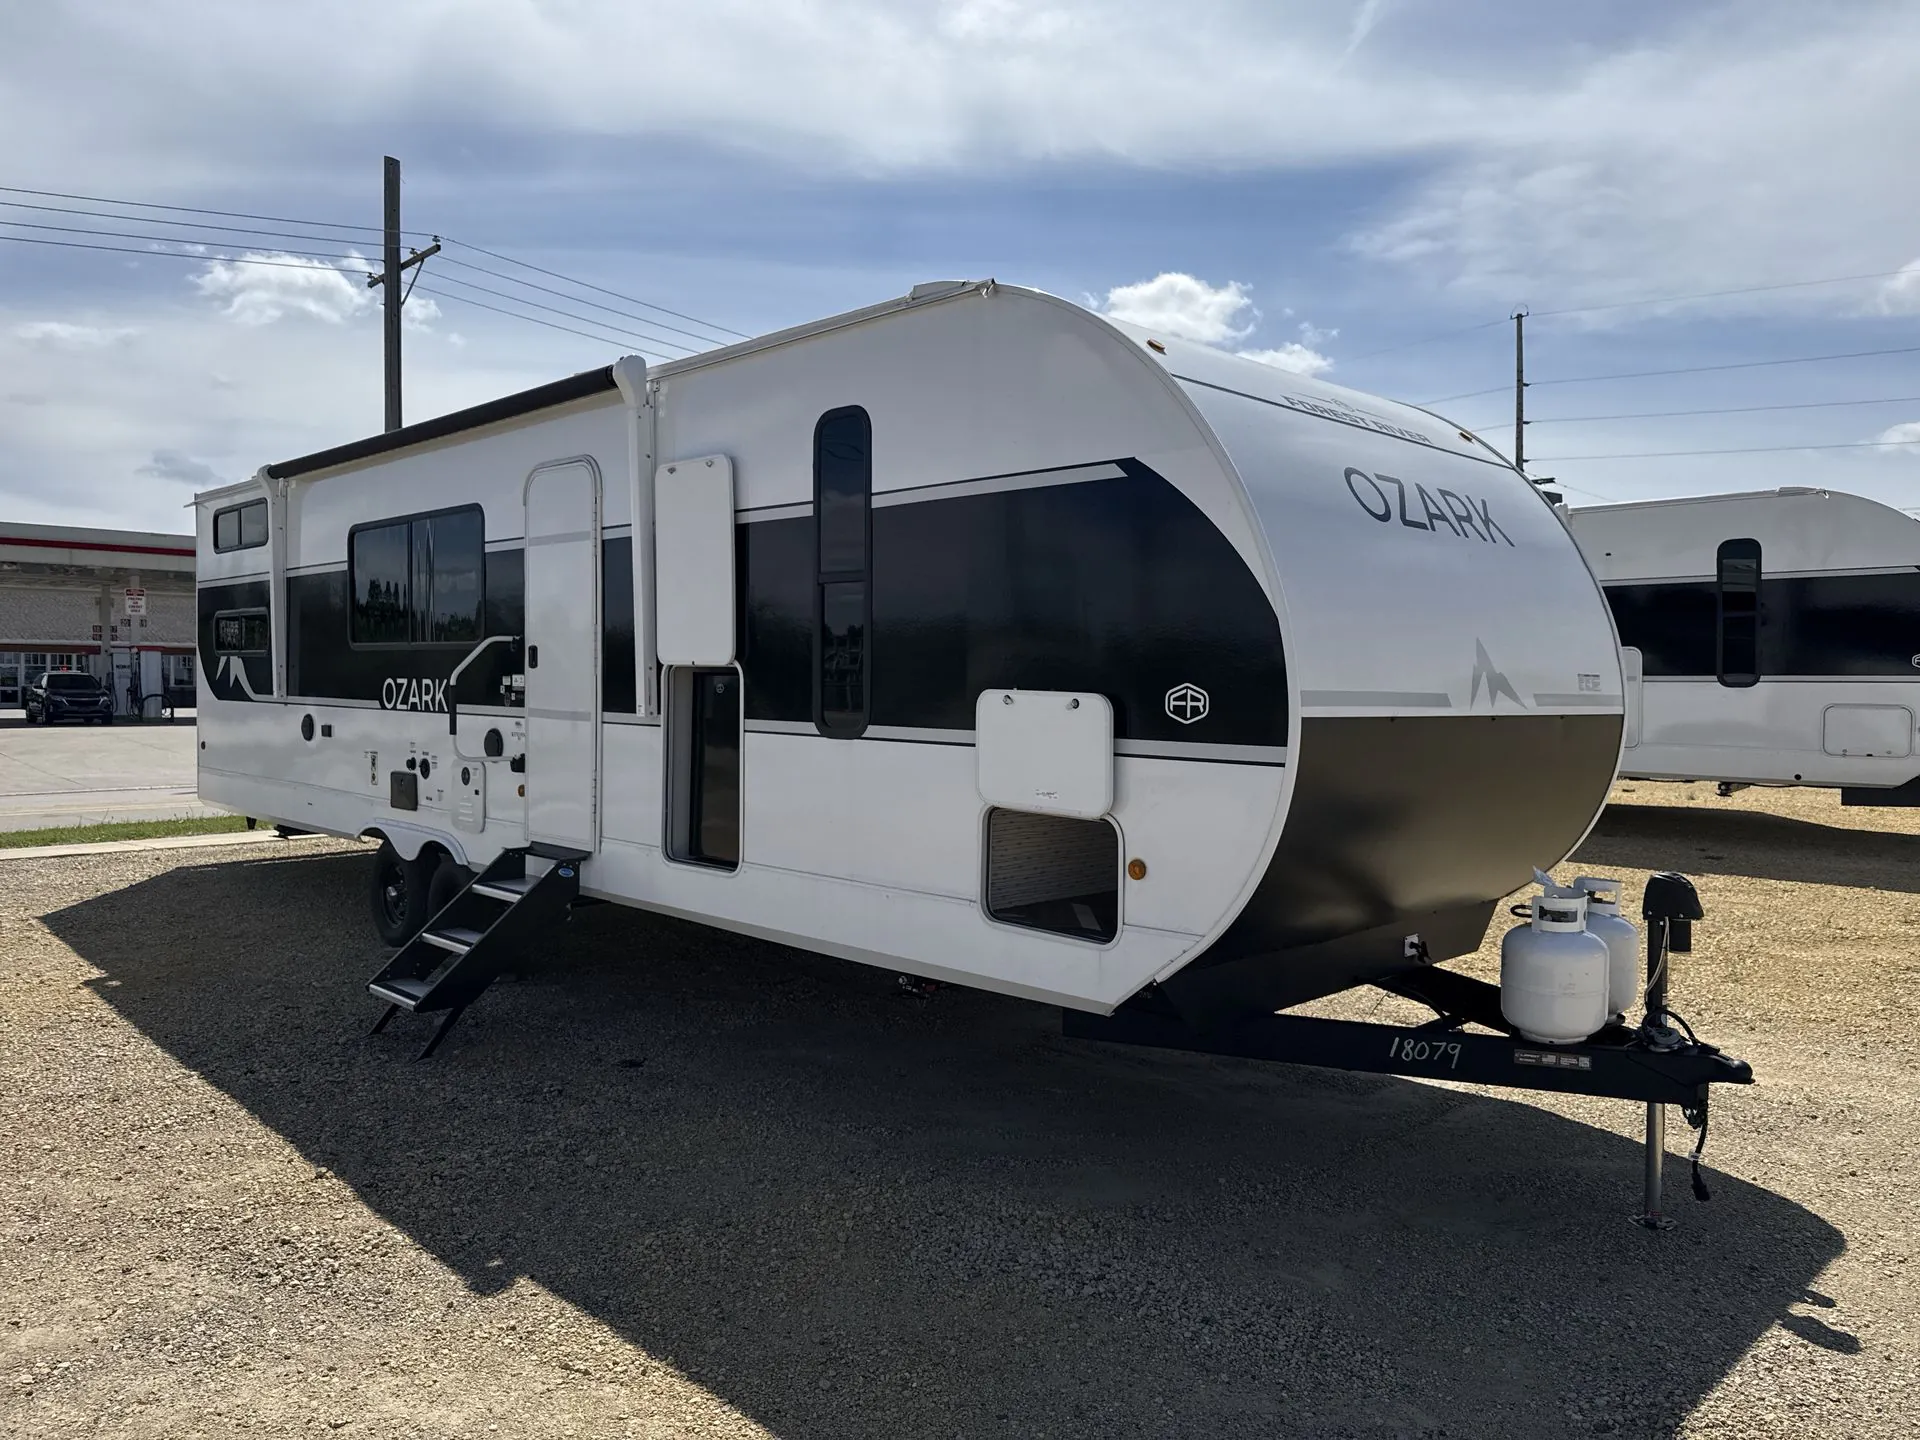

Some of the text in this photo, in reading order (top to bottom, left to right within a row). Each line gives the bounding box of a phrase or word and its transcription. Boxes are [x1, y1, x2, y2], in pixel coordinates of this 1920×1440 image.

[1279, 394, 1370, 427] FOREST
[1371, 419, 1434, 445] RIVER
[1343, 466, 1515, 547] OZARK
[382, 677, 449, 712] OZARK
[1389, 1037, 1462, 1070] 18079
